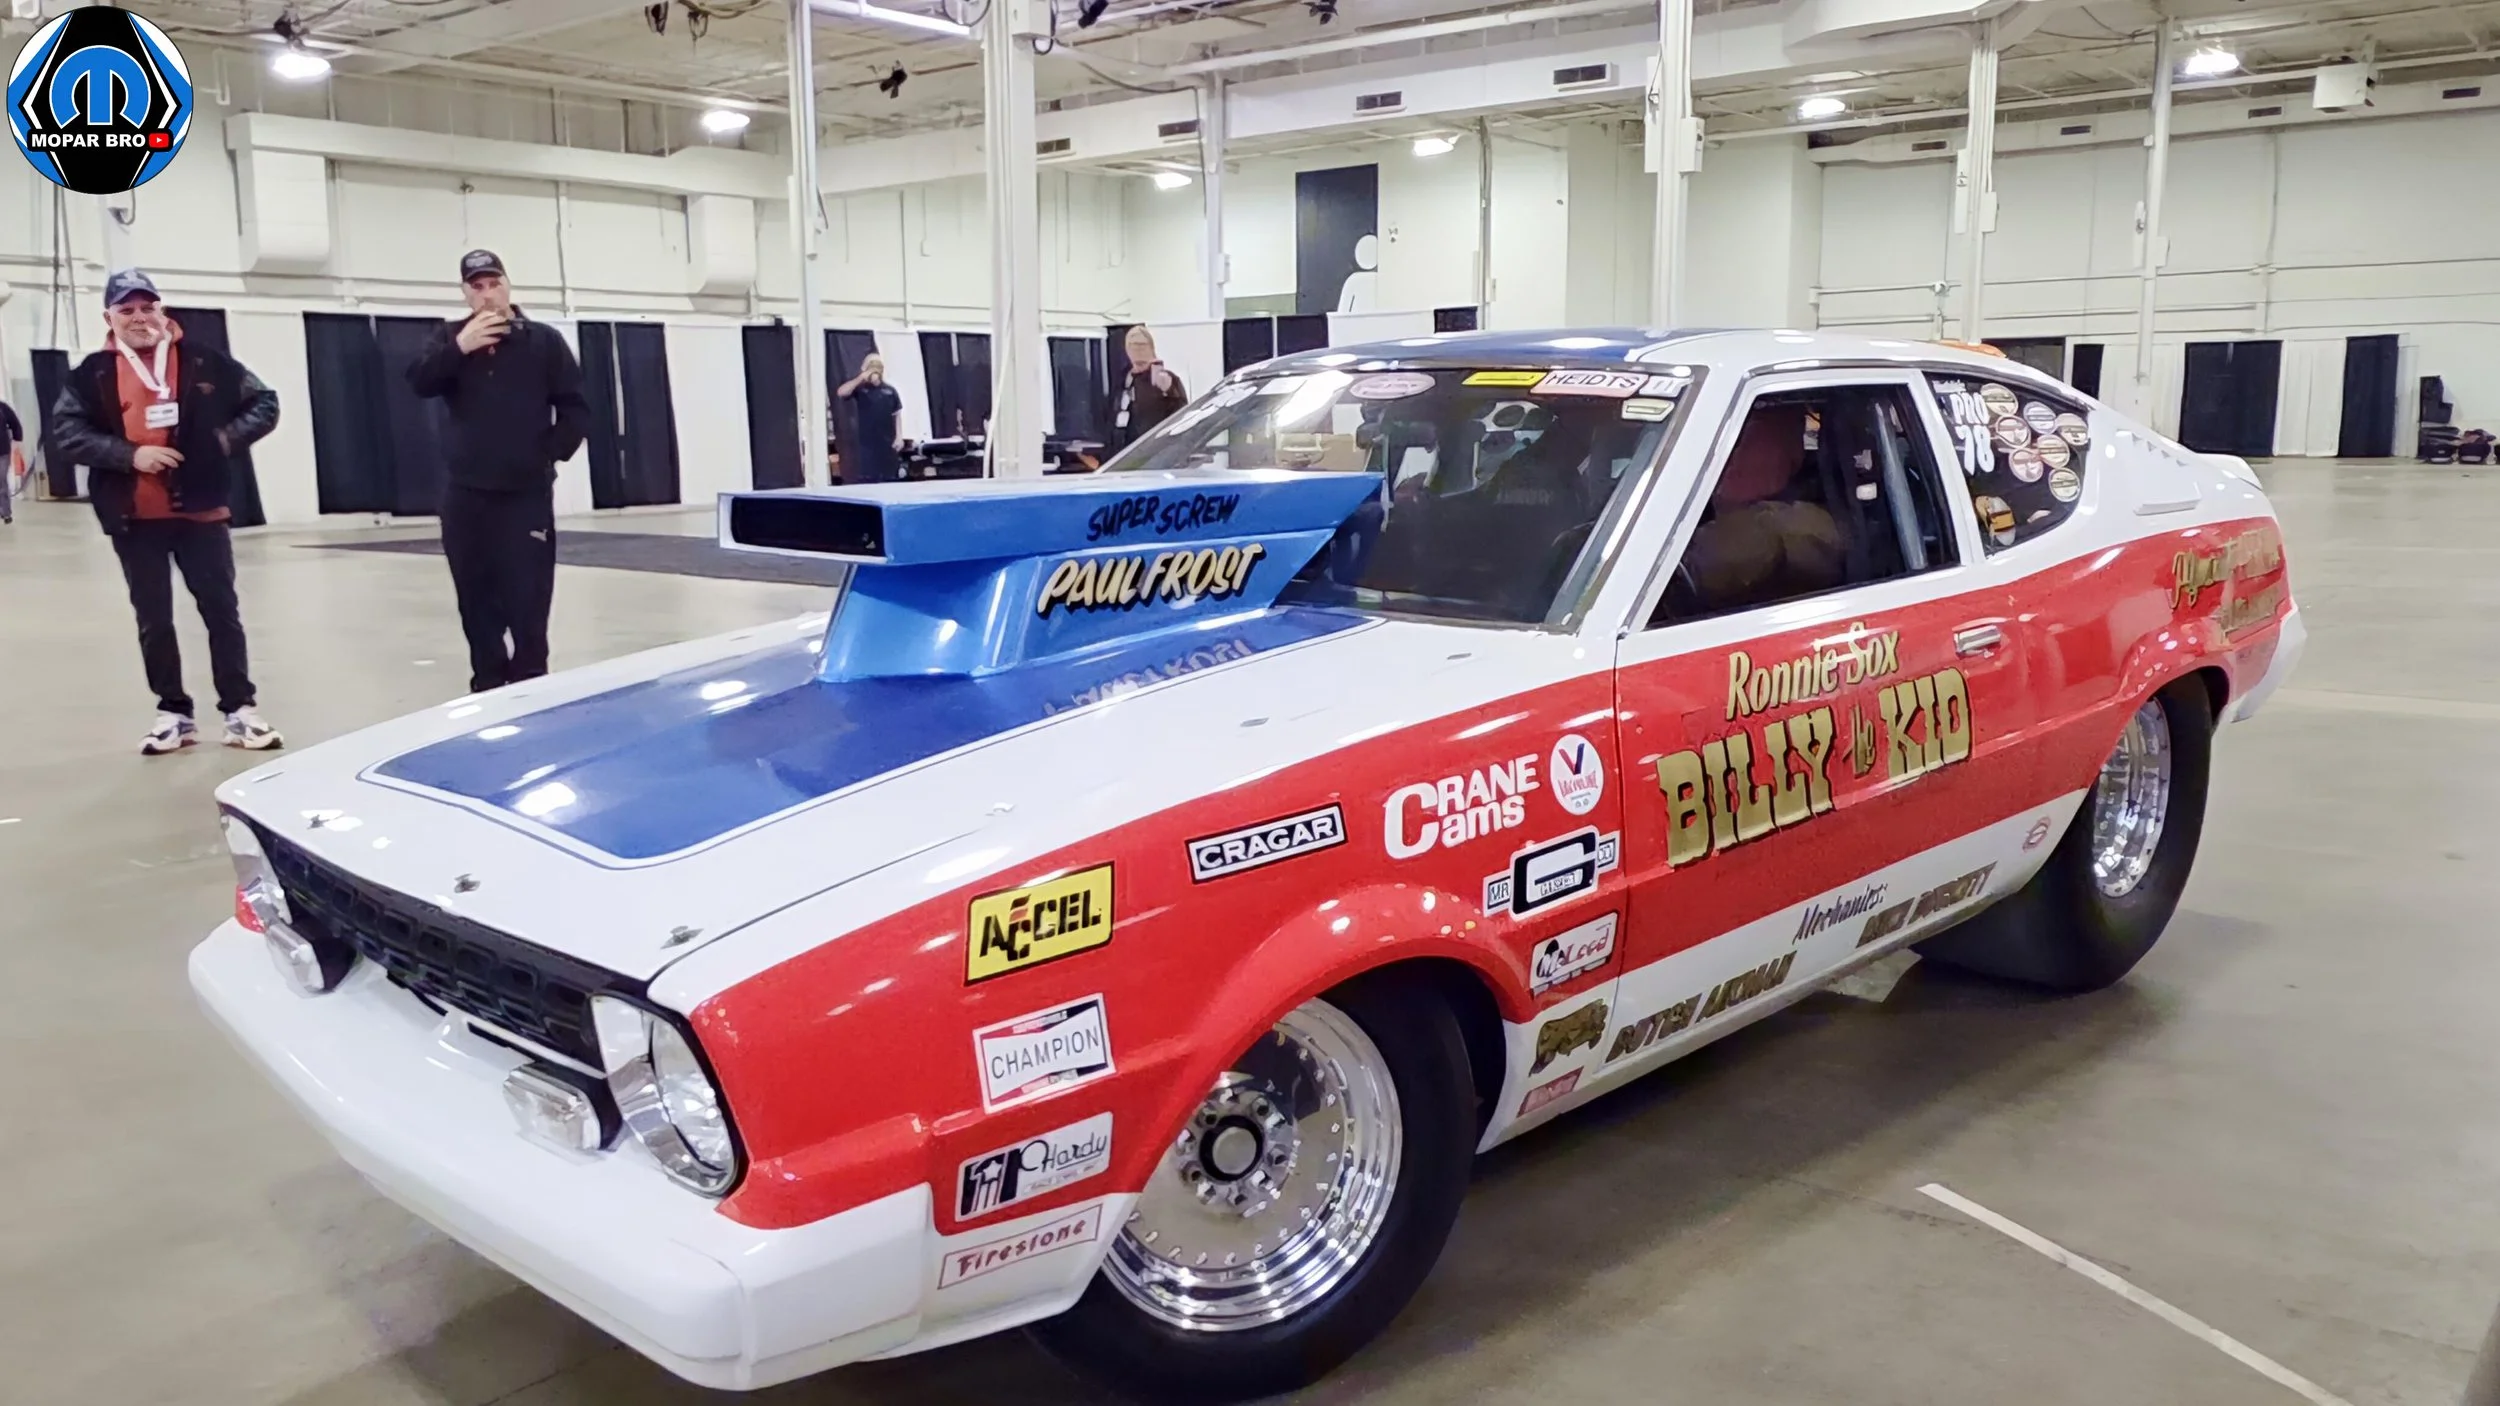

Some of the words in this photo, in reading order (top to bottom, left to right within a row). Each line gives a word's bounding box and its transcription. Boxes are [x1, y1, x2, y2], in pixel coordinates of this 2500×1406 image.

[1545, 373, 1640, 389] HEIDTS
[1949, 391, 1991, 425] PRO
[1086, 495, 1161, 542] SUPER
[1154, 493, 1241, 535] SCREW
[1036, 556, 1144, 616] PAUL
[1139, 543, 1266, 605] FROST
[1726, 642, 1839, 721] Ronnie
[1846, 622, 1899, 685] Sox
[1656, 706, 1836, 868] BILLY
[1878, 667, 1971, 782] KID
[1384, 753, 1541, 859] CRANE
[1199, 816, 1334, 869] CRAGAR
[979, 888, 1102, 961] ACCEL
[991, 1026, 1099, 1079] CHAMPION
[957, 1219, 1087, 1277] Firestone
